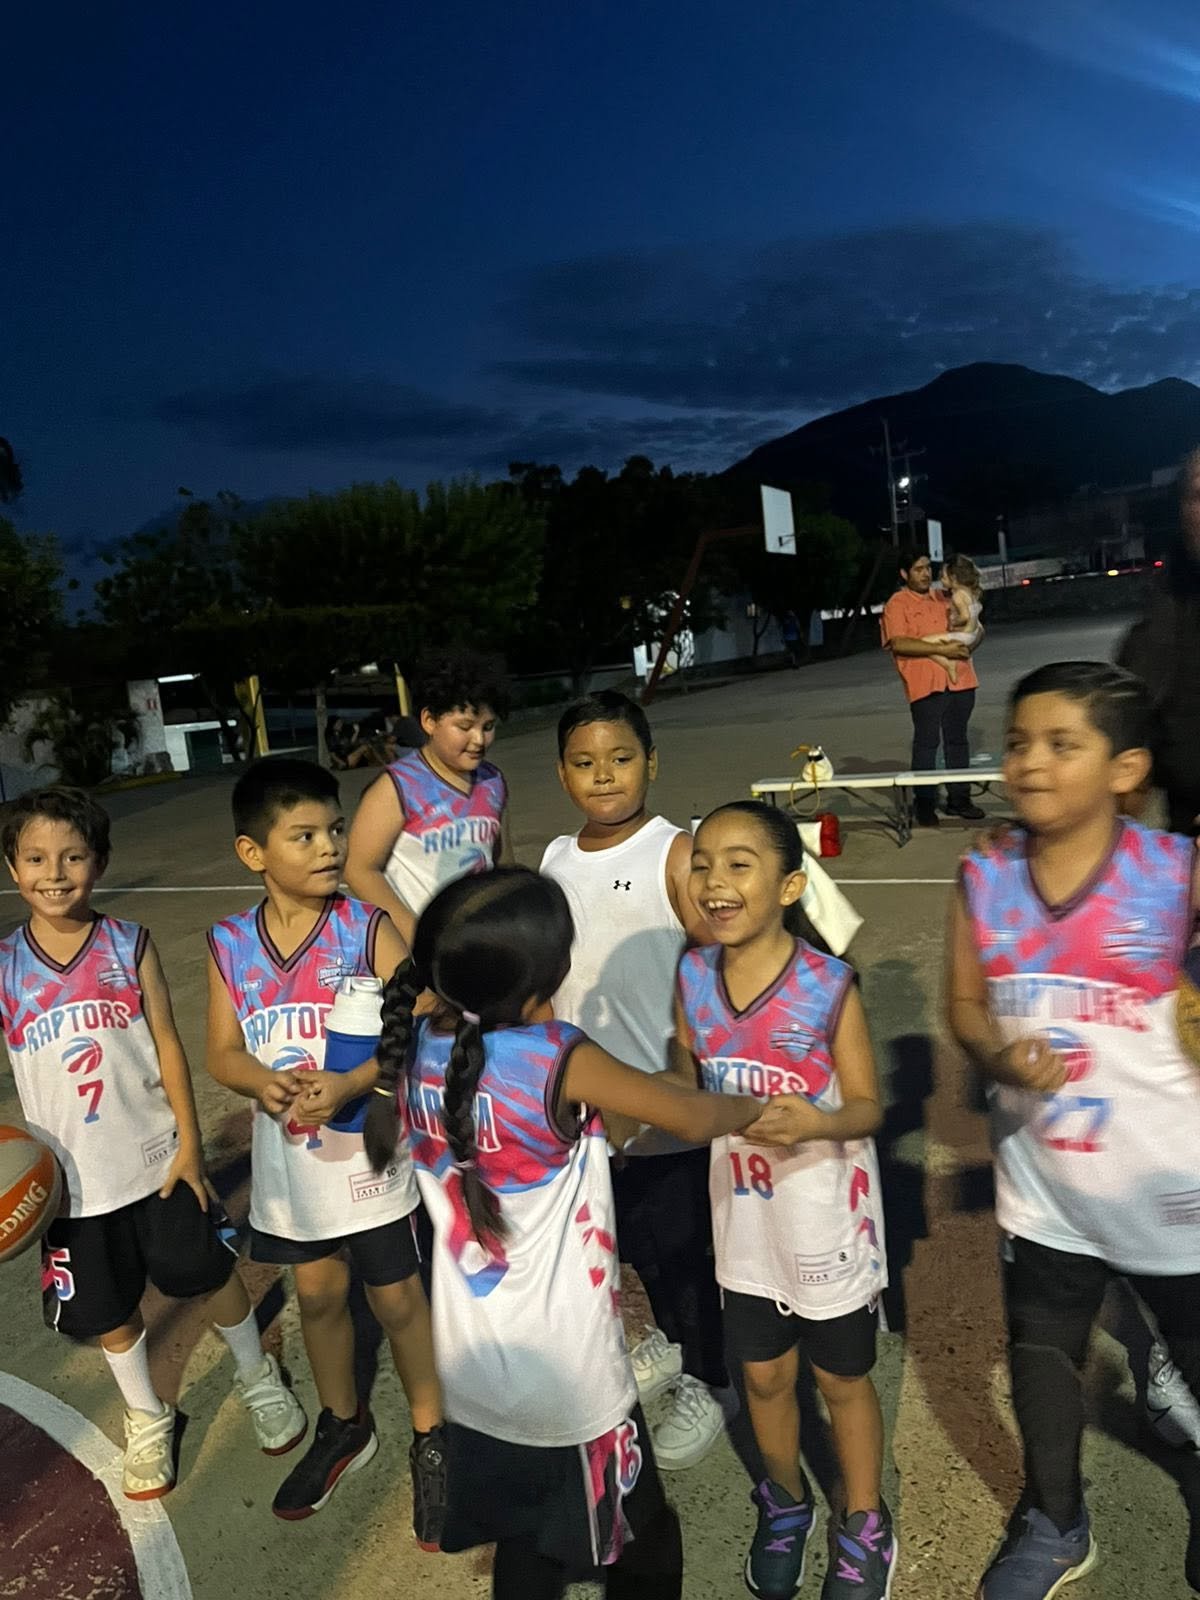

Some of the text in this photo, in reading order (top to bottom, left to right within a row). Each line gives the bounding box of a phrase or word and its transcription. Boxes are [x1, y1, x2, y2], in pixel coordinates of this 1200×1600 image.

[422, 816, 499, 854] RAPTOR
[24, 1000, 131, 1055] RAPTORS
[78, 1079, 104, 1124] 7
[730, 1151, 774, 1201] 18
